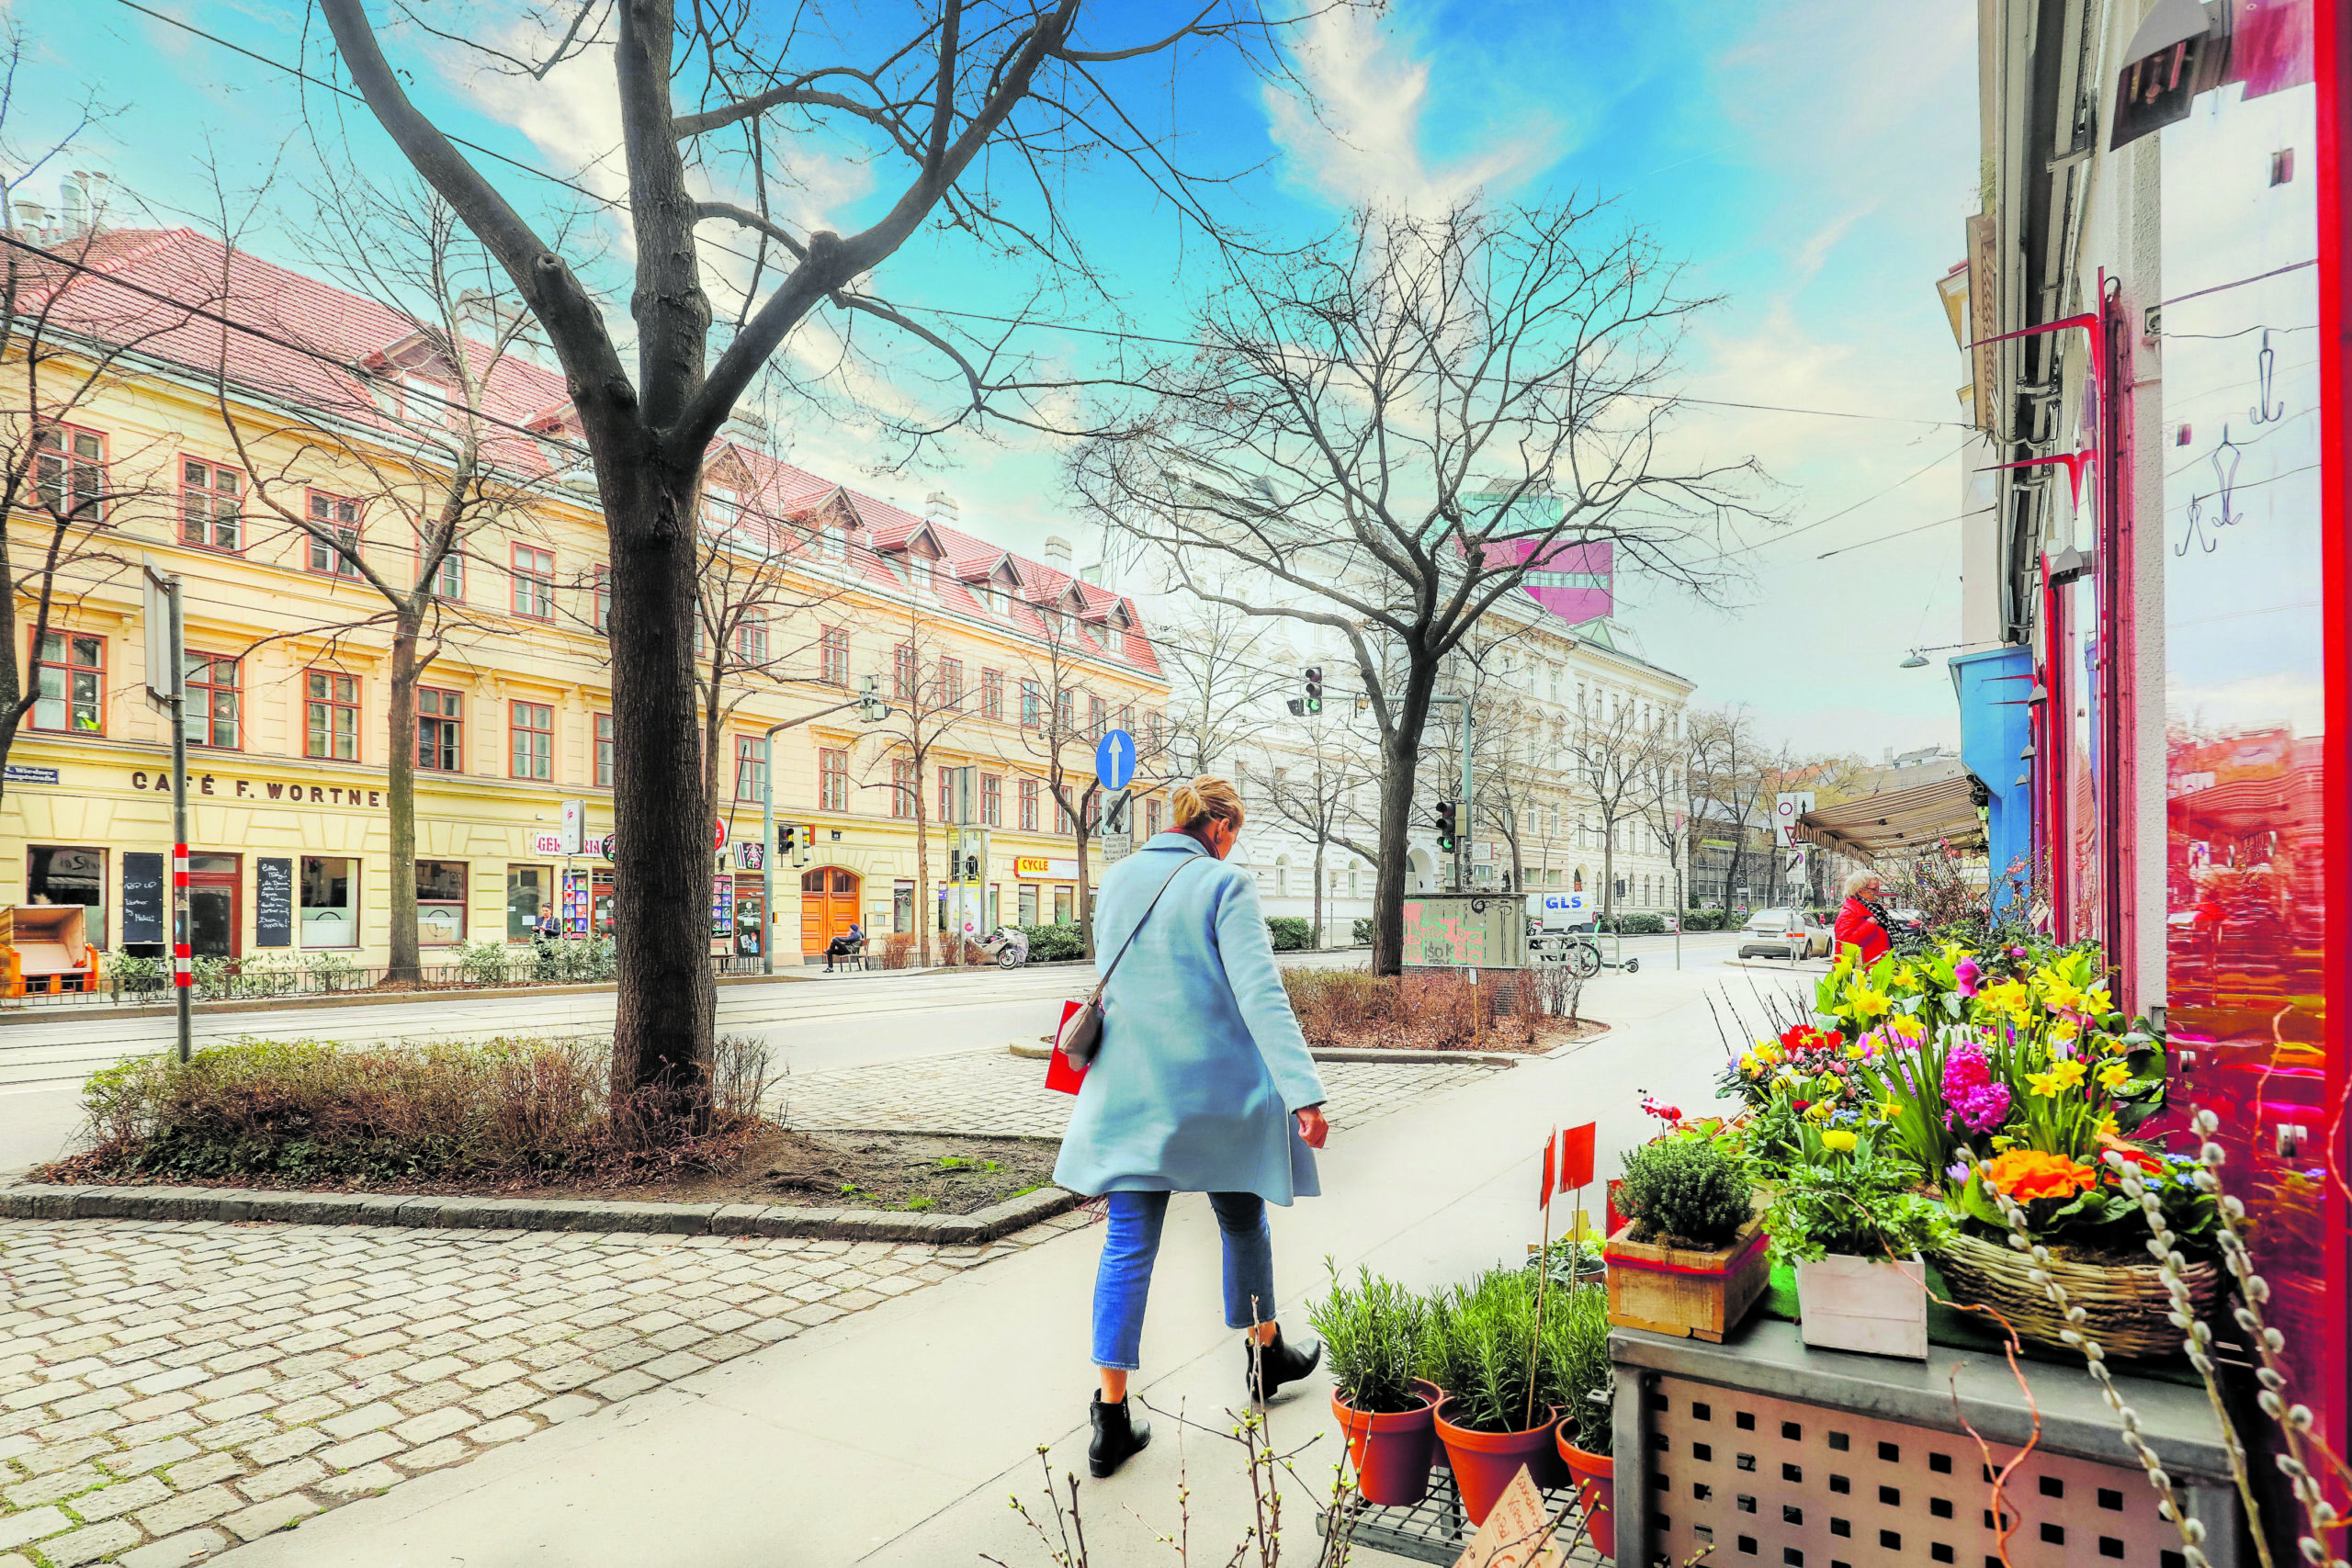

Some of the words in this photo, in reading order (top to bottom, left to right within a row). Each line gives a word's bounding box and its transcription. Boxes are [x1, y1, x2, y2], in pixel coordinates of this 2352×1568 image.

[236, 780, 254, 798] F.
[267, 783, 390, 807] WORTNE
[1023, 859, 1049, 871] CYCLE
[1546, 897, 1581, 908] GLS
